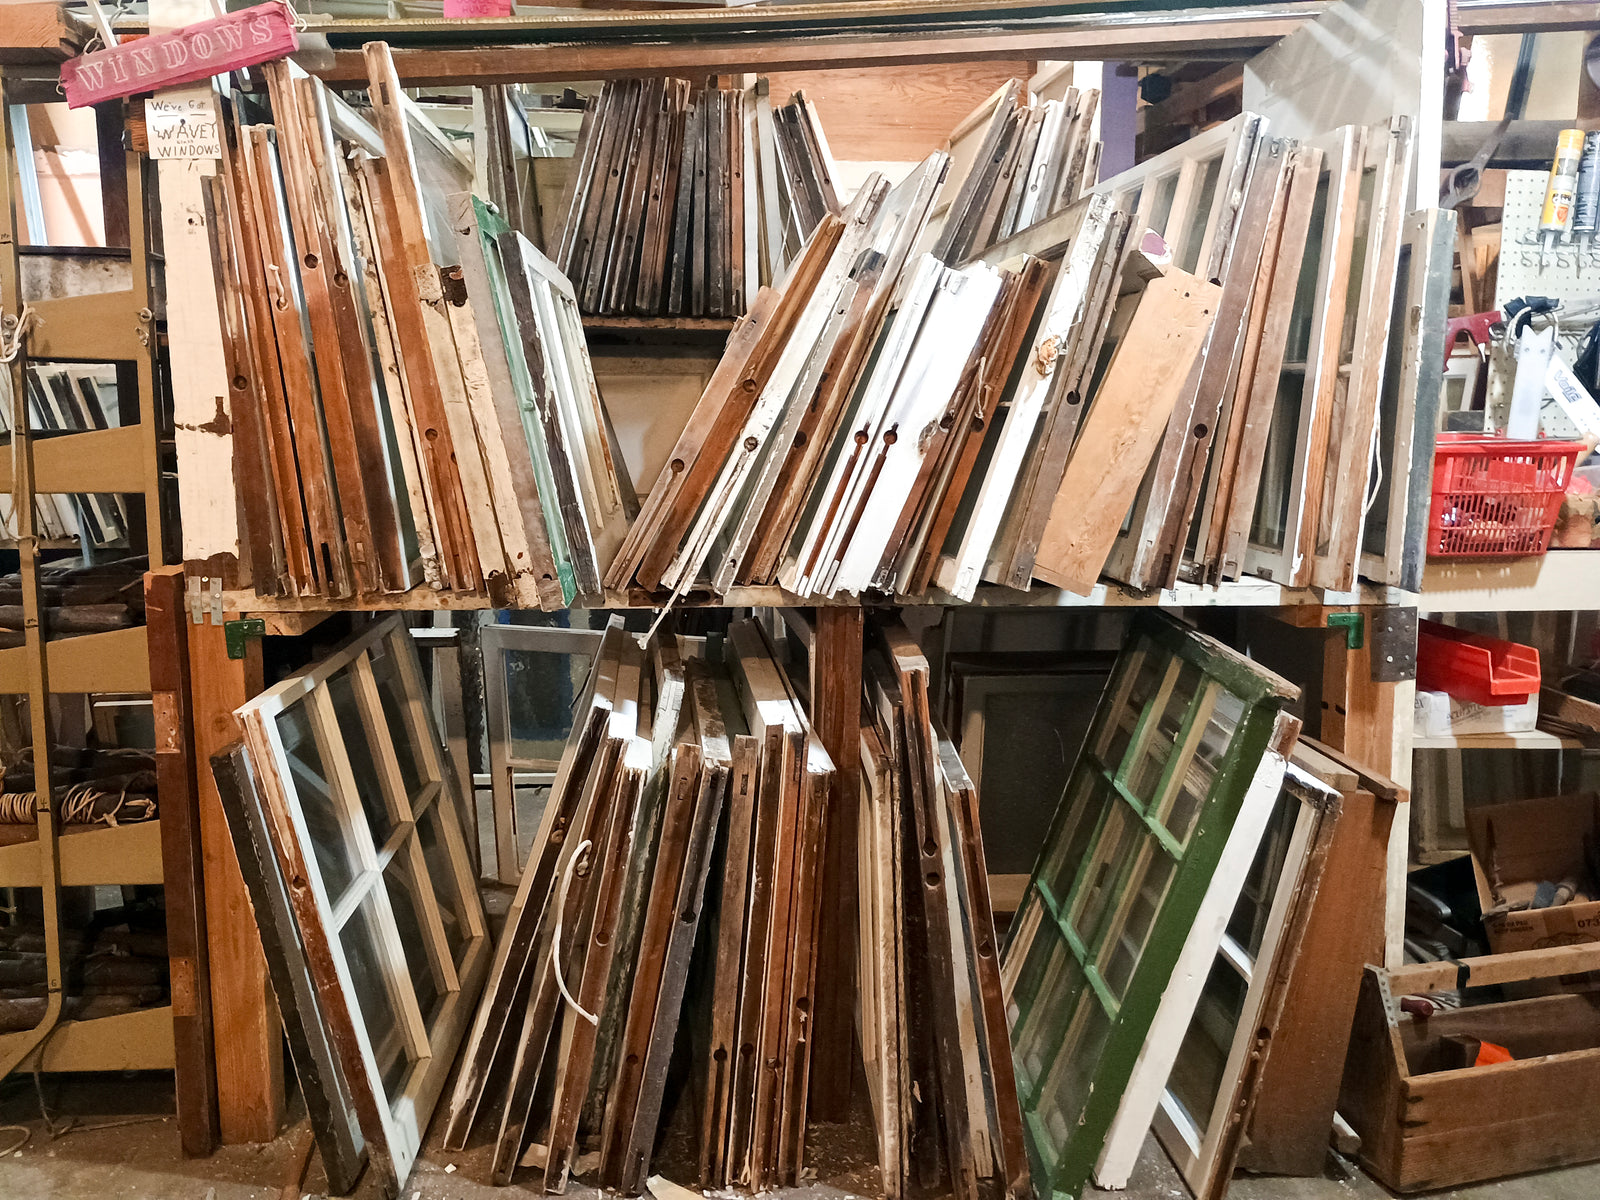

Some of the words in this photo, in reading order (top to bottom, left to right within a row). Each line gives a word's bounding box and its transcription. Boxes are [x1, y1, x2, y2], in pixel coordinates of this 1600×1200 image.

[76, 16, 273, 92] WINDOWS
[151, 100, 183, 111] We've
[188, 100, 206, 109] Got
[152, 120, 217, 140] WAVEY
[157, 144, 220, 157] WINDOWS
